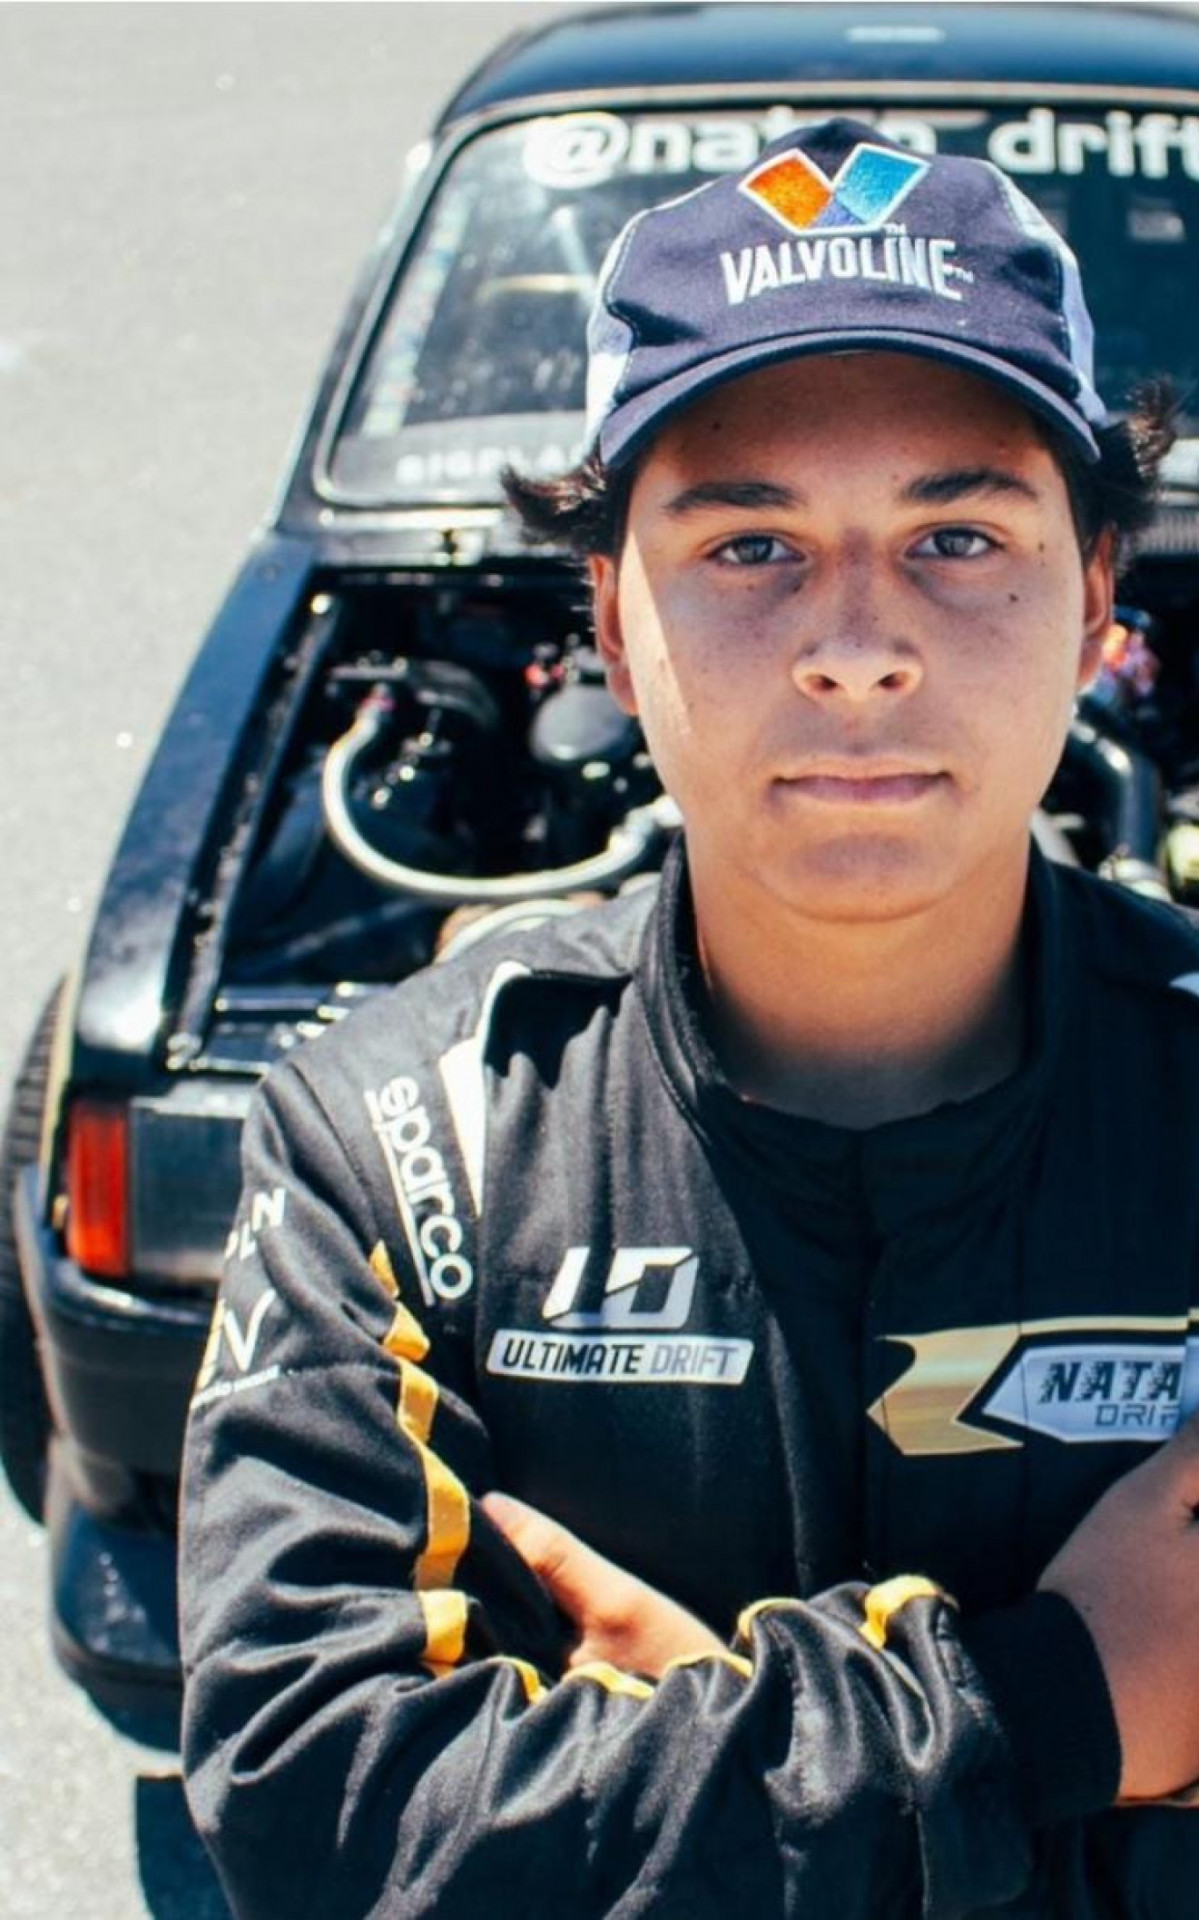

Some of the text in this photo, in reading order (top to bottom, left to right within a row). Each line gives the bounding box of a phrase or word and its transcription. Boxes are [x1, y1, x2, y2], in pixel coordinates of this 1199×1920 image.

[719, 236, 963, 305] VALVOLINE
[379, 1077, 474, 1300] sparco
[503, 1338, 739, 1375] ULTIMATE DRIFT
